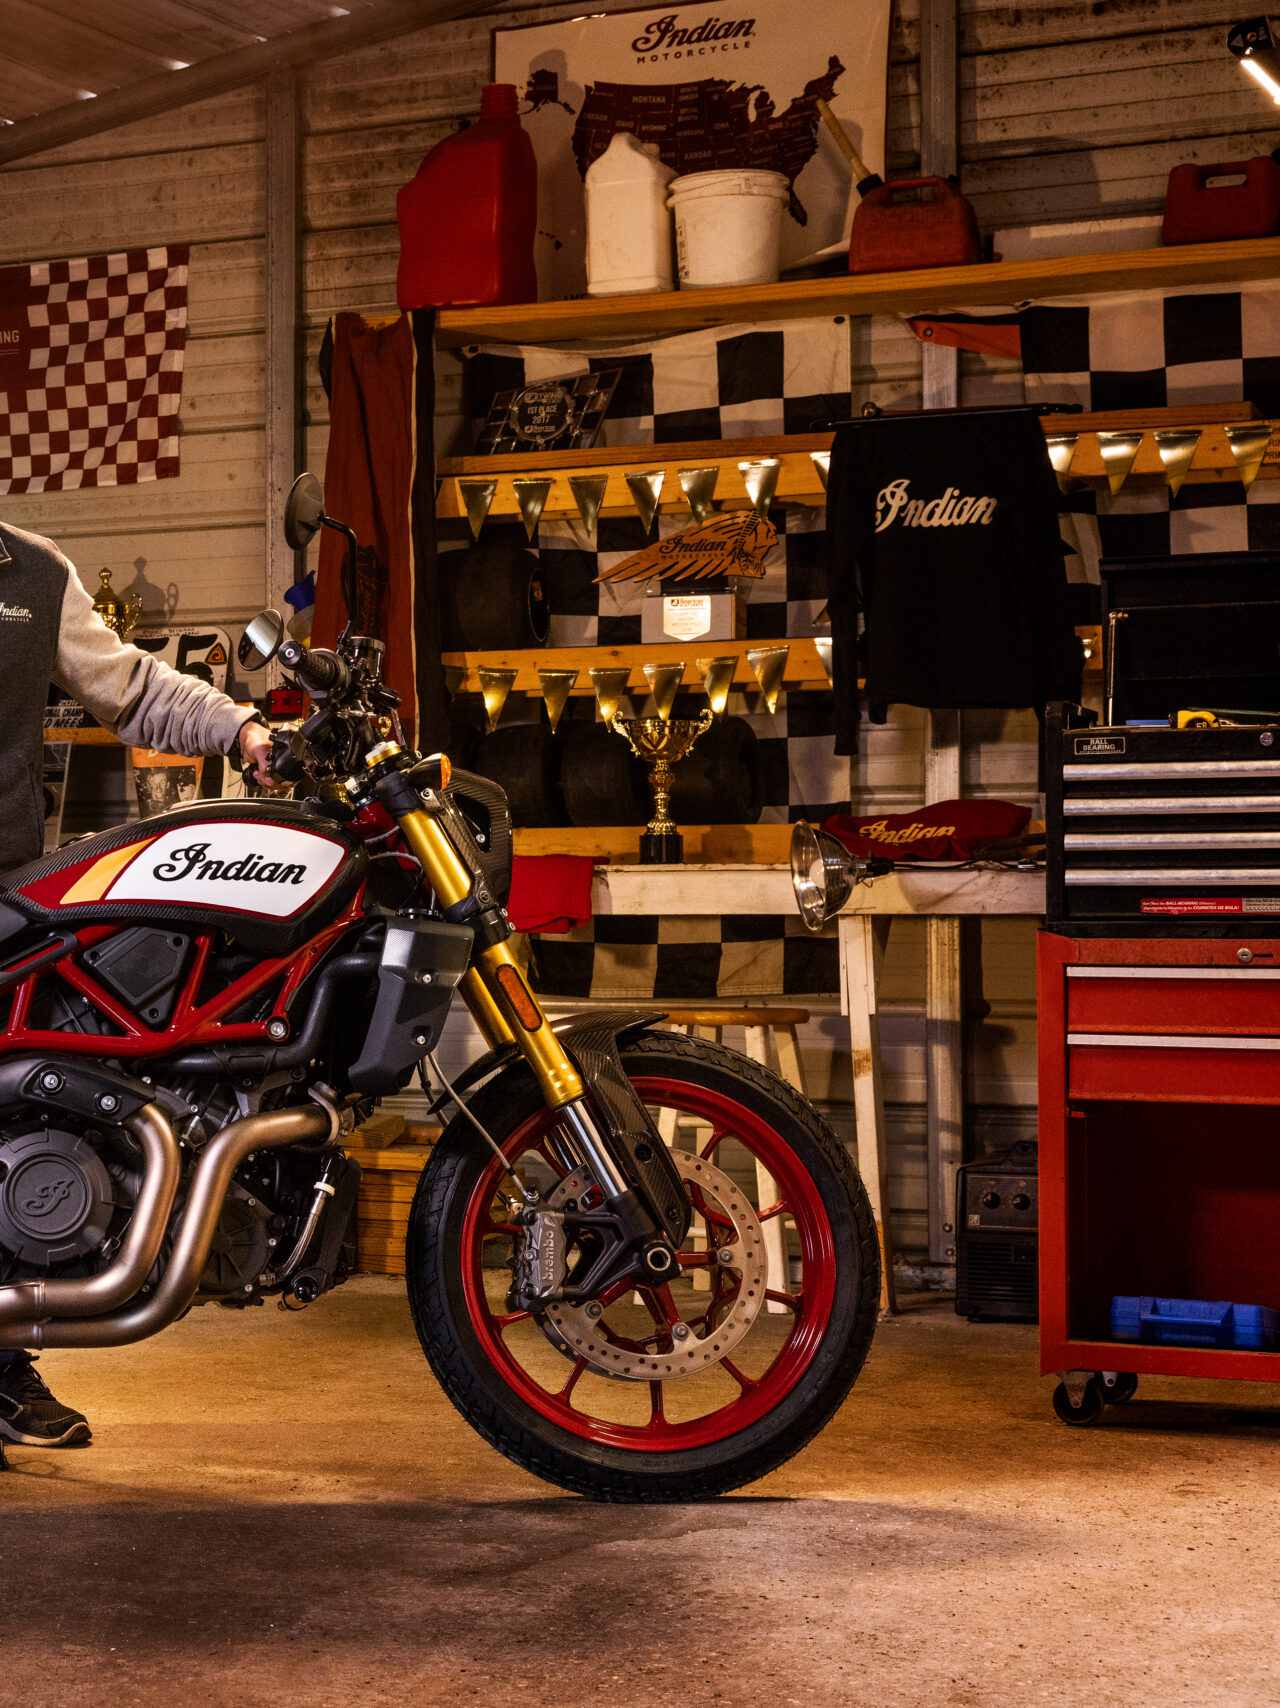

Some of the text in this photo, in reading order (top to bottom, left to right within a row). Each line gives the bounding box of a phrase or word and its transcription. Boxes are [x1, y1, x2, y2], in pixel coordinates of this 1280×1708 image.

[632, 15, 755, 53] Indian
[637, 41, 751, 64] MOTORCYCLE
[632, 96, 666, 104] MONTANA
[684, 150, 712, 160] KANSAS
[527, 404, 558, 414] 1ST PLACE
[532, 416, 550, 424] 2017
[875, 478, 998, 534] Indian
[659, 535, 727, 554] Indian
[1082, 743, 1116, 751] BEARING
[1089, 738, 1109, 746] BALL
[859, 820, 956, 844] Indian
[152, 843, 307, 885] Indian
[542, 1230, 555, 1281] brembo
